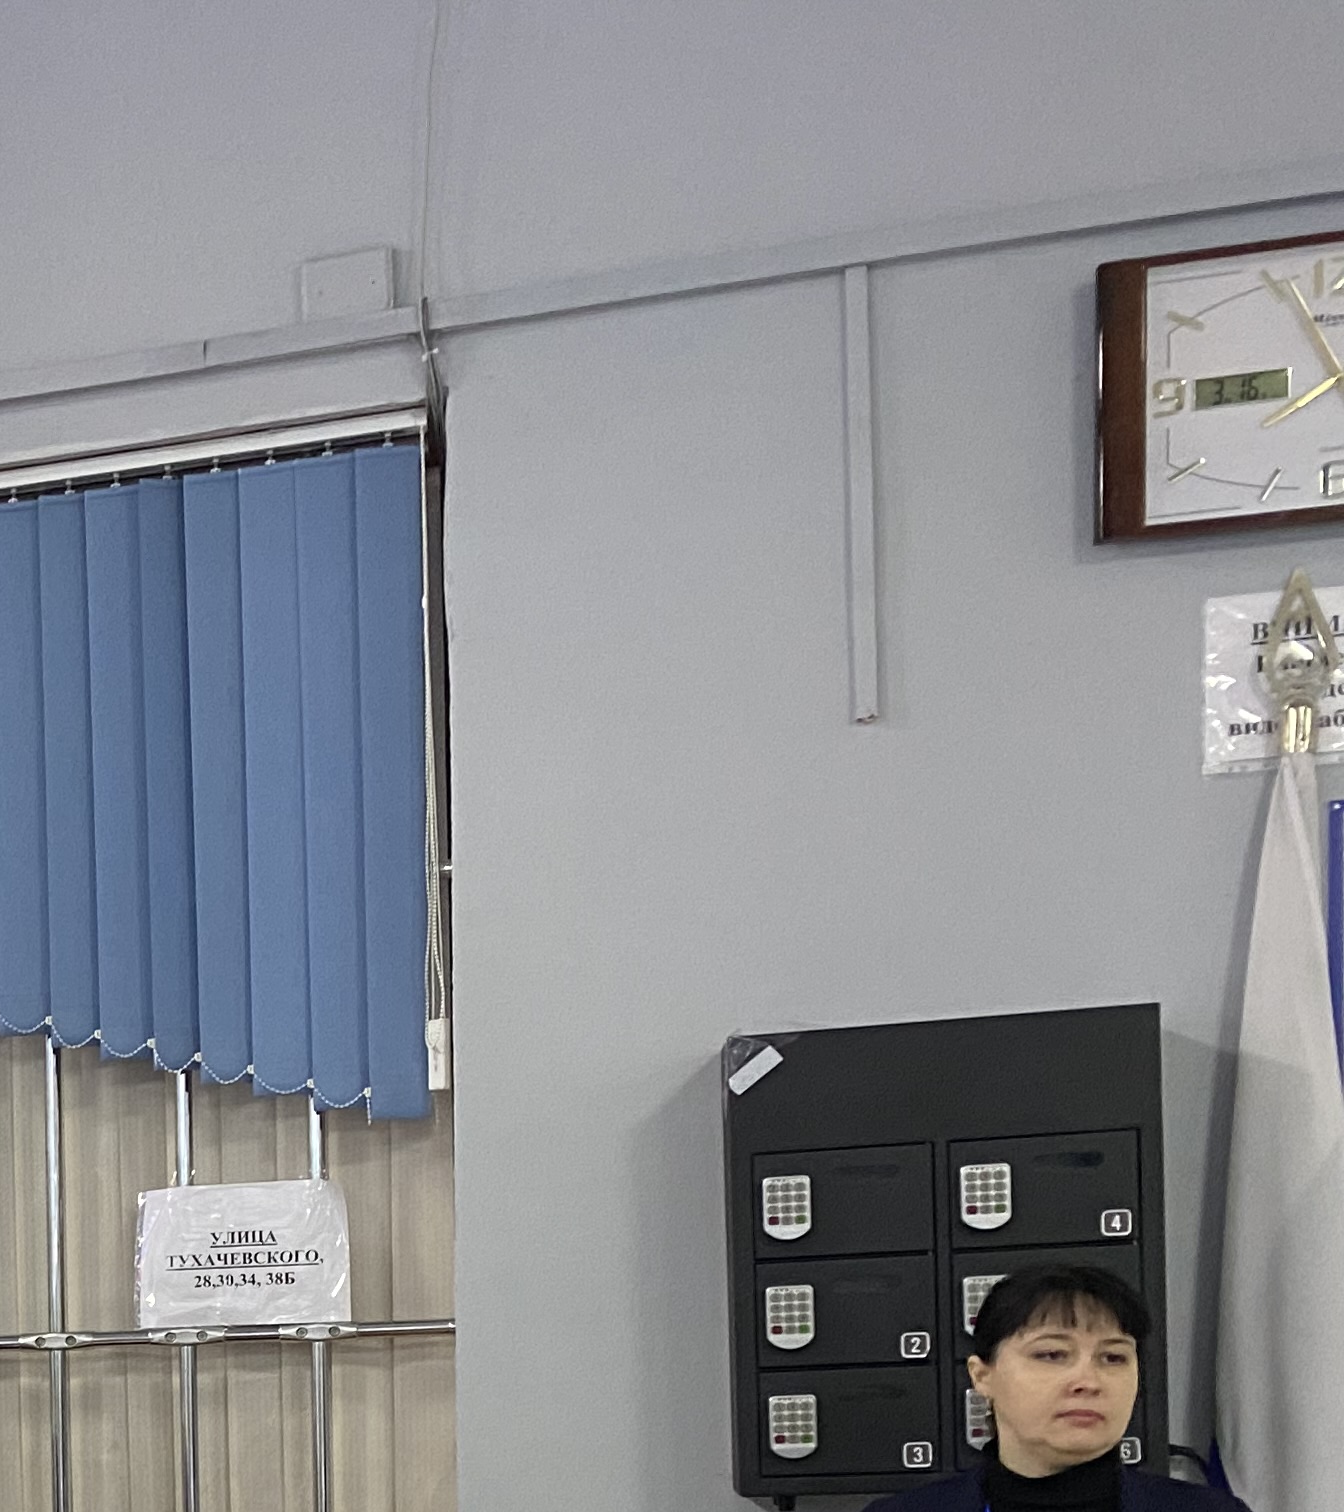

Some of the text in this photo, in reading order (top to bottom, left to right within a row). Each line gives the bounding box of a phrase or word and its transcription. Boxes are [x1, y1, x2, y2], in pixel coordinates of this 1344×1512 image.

[1111, 1215, 1122, 1231] 4
[210, 1230, 277, 1245] УЛИЦА
[166, 1249, 324, 1268] ТУХАЧЕВСКОГО,
[266, 1272, 295, 1286] 38Б
[911, 1337, 921, 1353] 2
[913, 1447, 923, 1463] 3
[1120, 1442, 1131, 1459] 6
